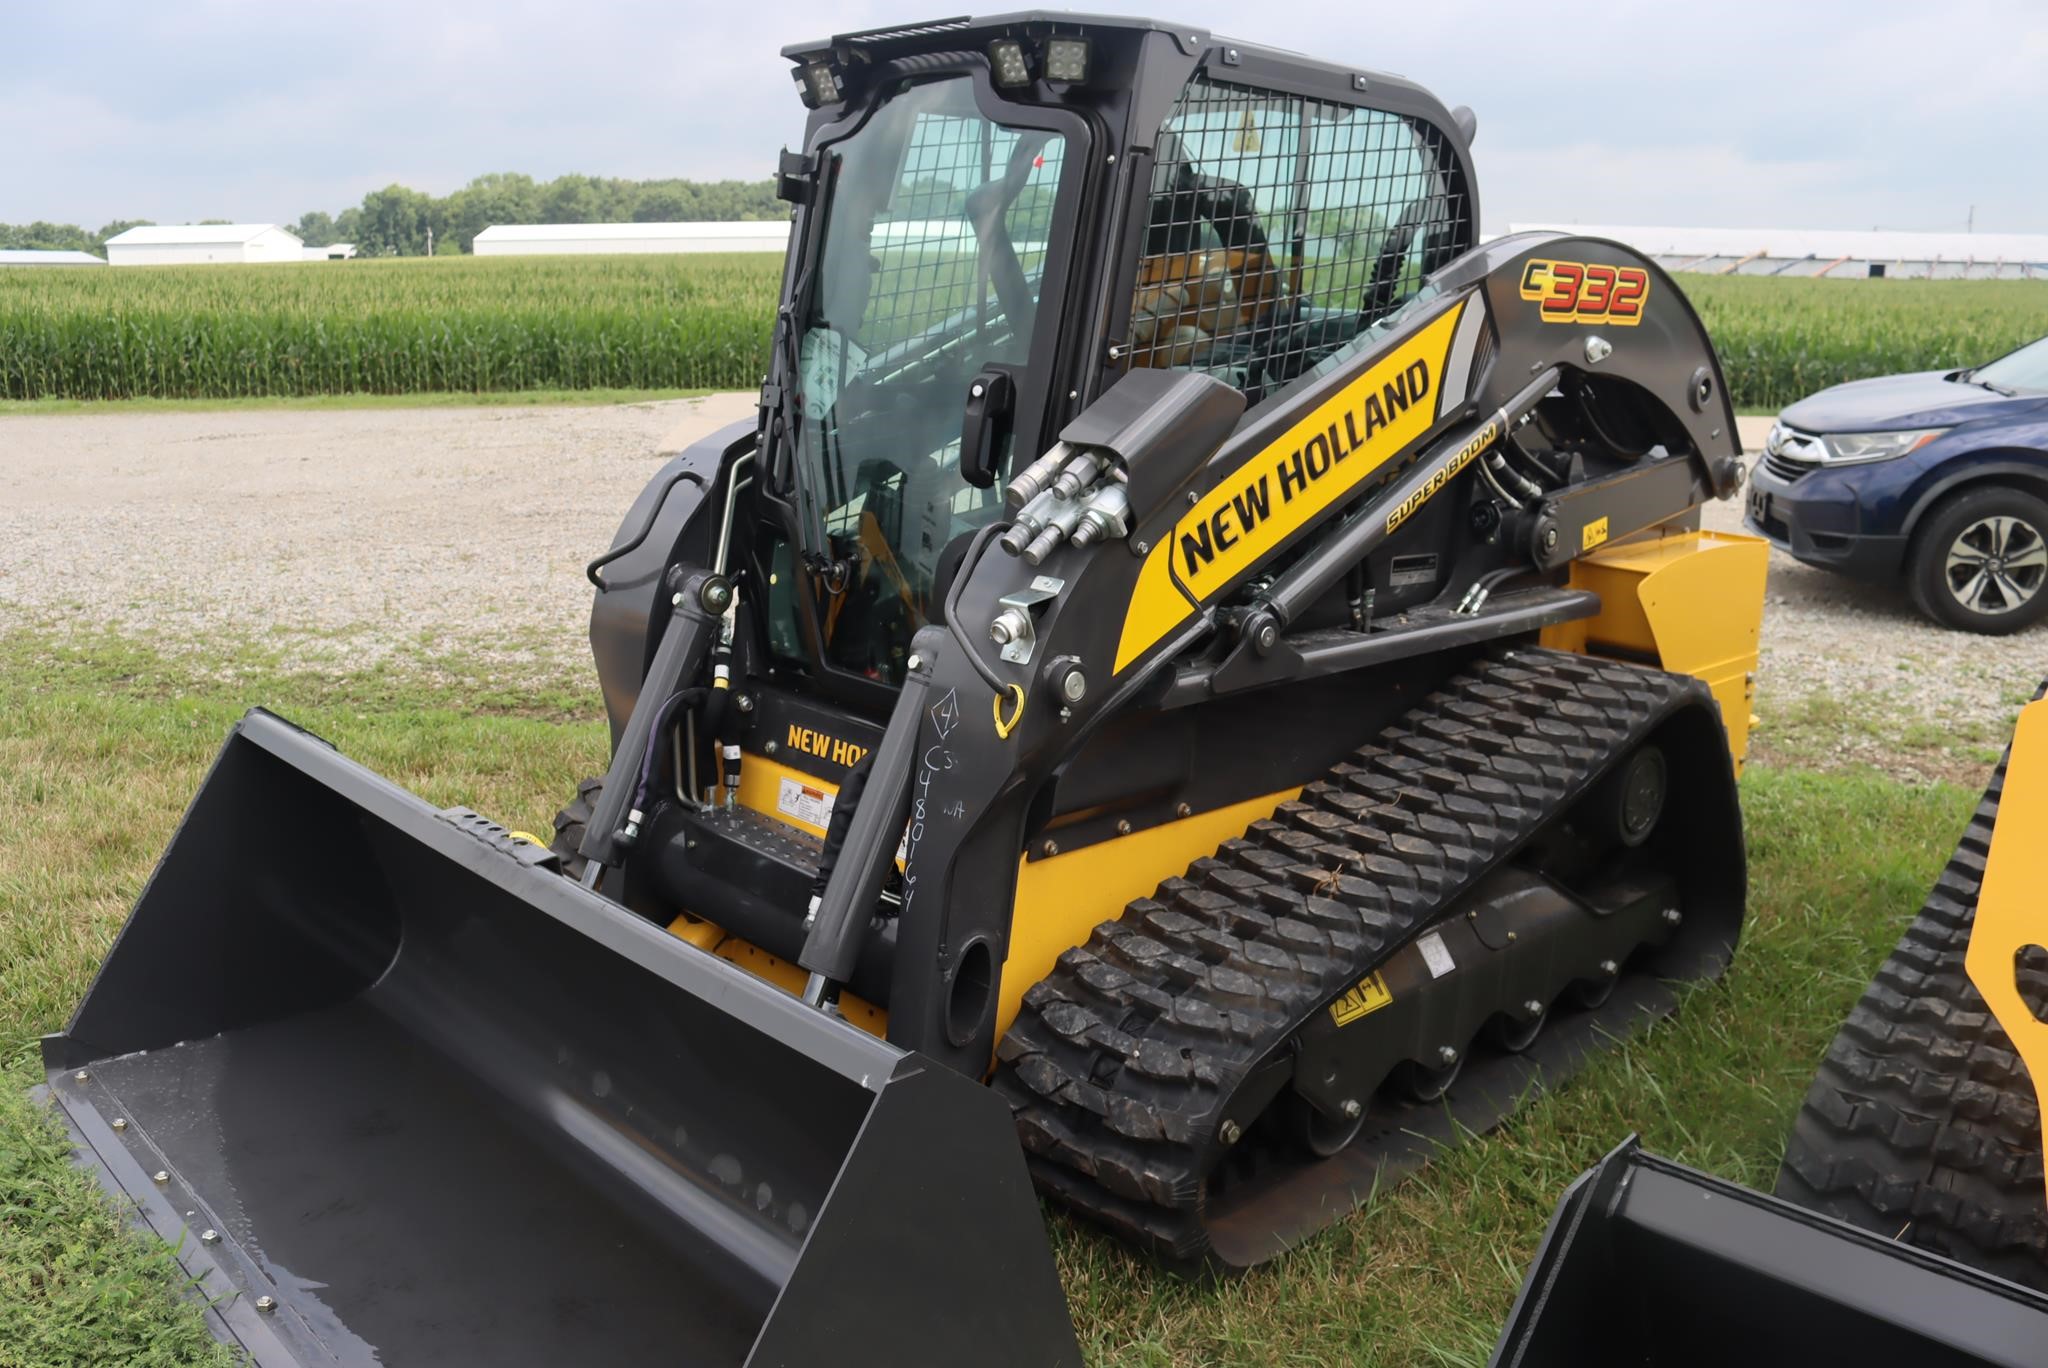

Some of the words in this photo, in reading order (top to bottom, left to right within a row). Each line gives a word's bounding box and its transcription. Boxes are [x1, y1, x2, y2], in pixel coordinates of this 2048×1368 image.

[1521, 261, 1648, 323] C332
[1179, 473, 1271, 577] NEW
[1276, 358, 1429, 504] HOLLAND
[1387, 469, 1446, 532] SUPER
[1447, 424, 1496, 478] BOOM
[787, 724, 831, 759] NEW
[832, 739, 868, 768] HO
[940, 702, 953, 730] 4
